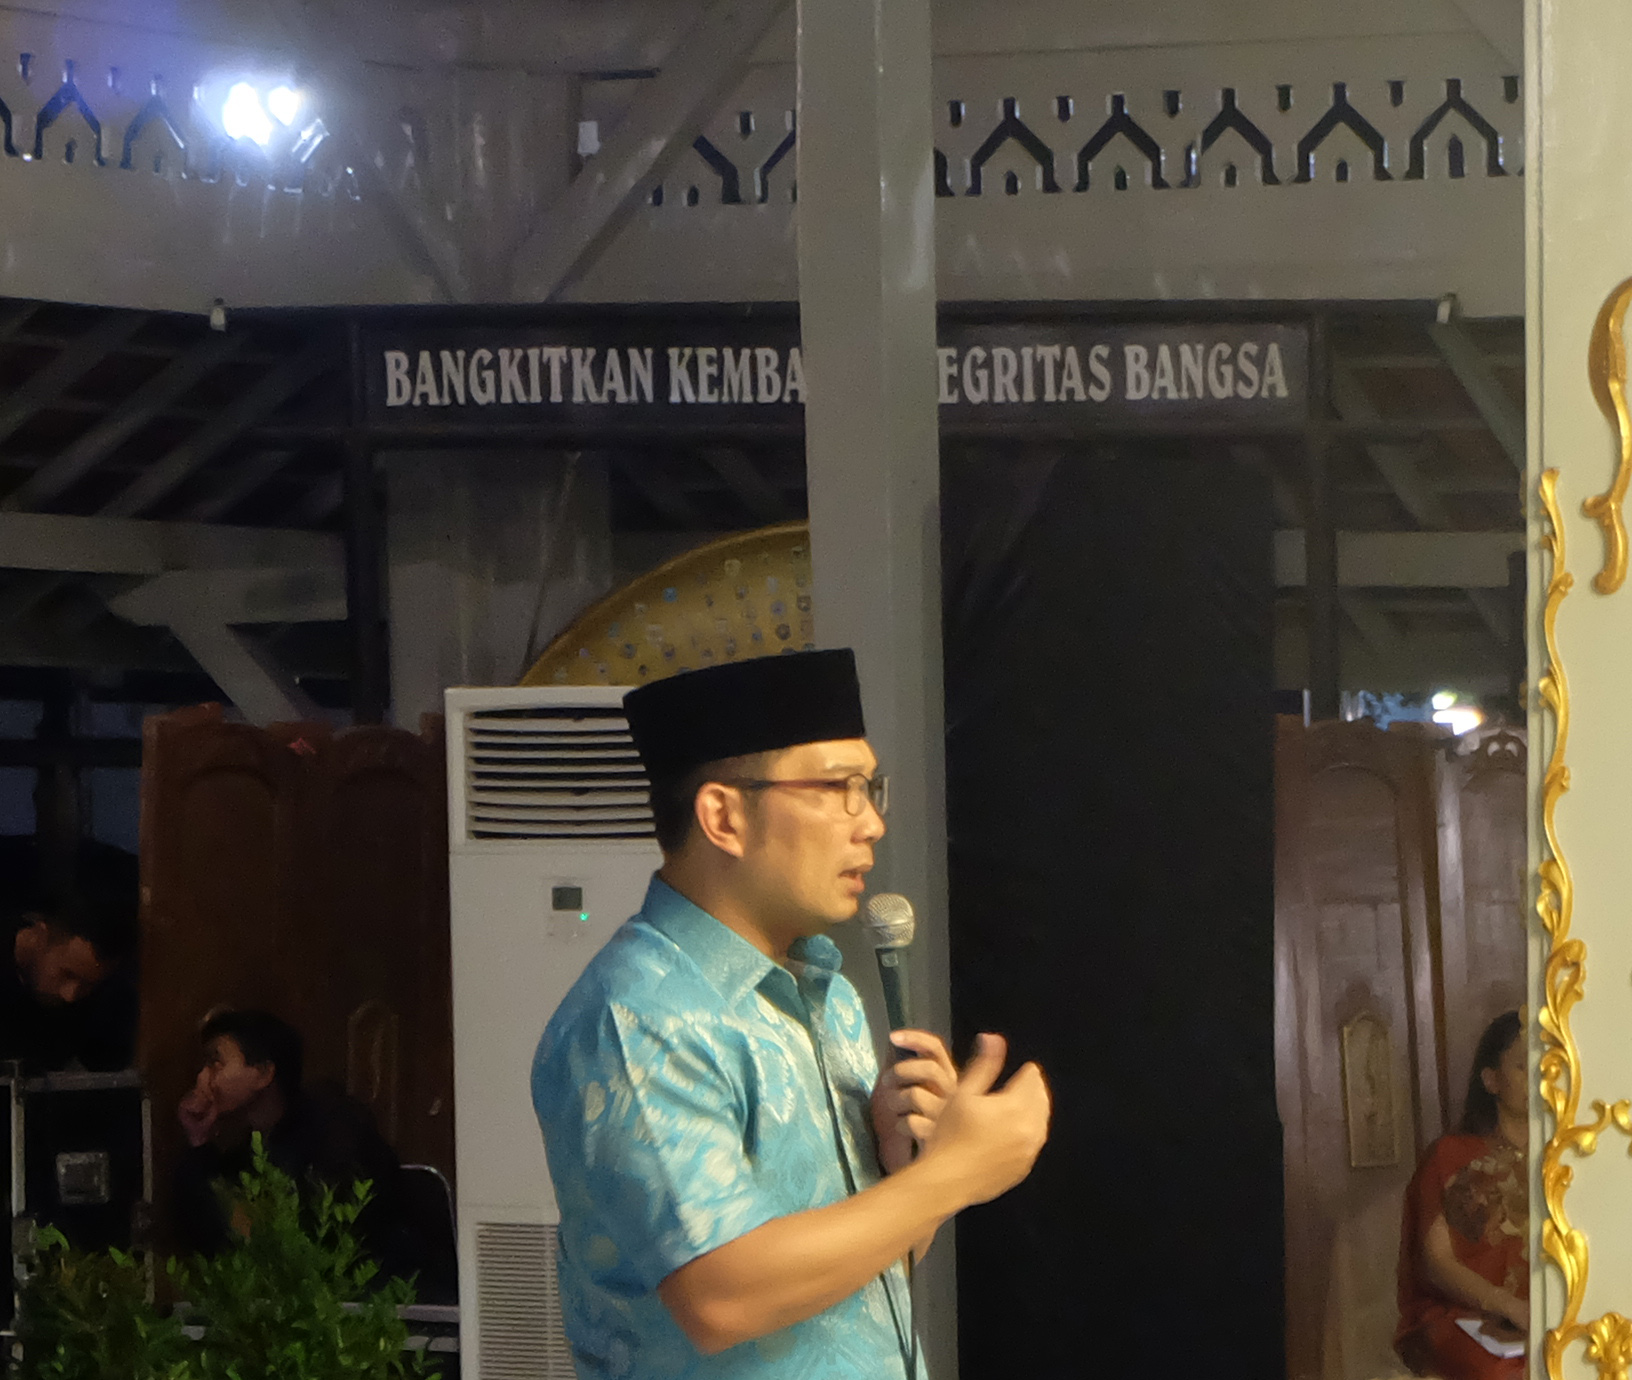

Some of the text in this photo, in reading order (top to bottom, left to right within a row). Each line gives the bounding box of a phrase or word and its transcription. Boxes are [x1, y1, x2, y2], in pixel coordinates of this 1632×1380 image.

[384, 342, 1289, 407] BANGKITKAN KEMBA EGRITAS BANGSA
